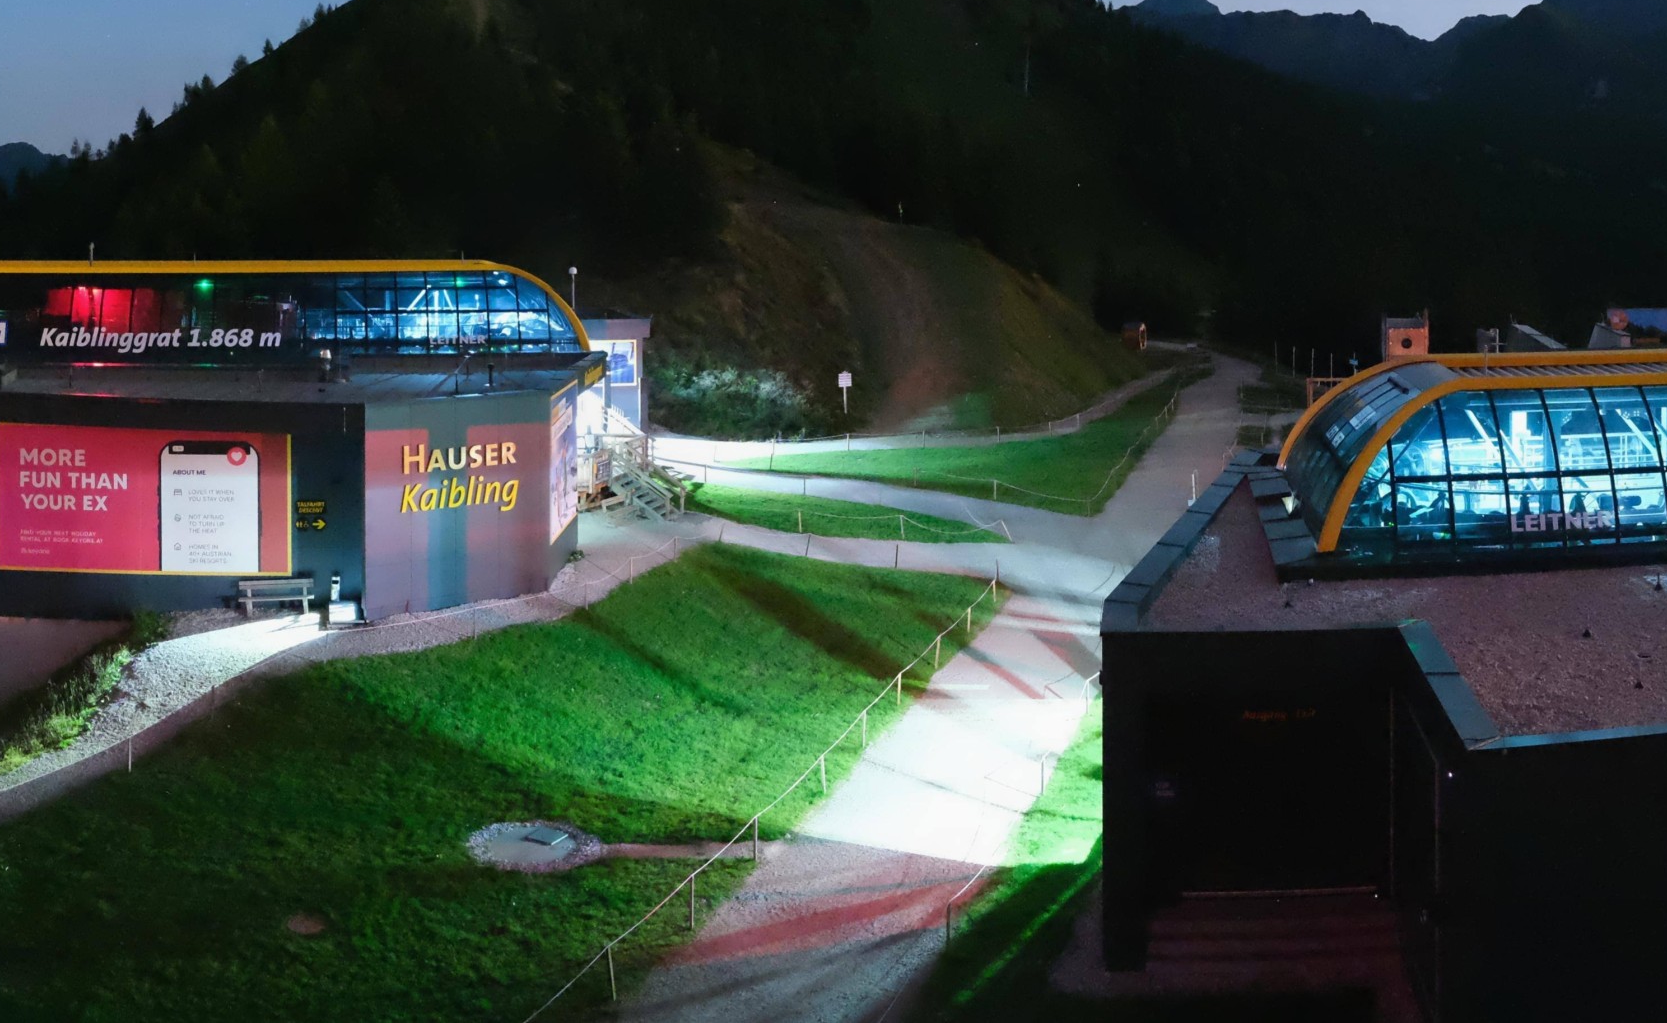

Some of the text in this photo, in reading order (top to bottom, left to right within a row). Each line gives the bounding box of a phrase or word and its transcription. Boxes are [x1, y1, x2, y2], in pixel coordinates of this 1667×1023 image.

[39, 327, 282, 354] Kaiblinggrat 1.868 m
[429, 334, 488, 345] LEITNER
[19, 448, 86, 466] MORE
[402, 442, 517, 474] HAUSER
[19, 471, 129, 490] FUN THAN
[20, 493, 109, 511] YOUR EX
[400, 475, 520, 514] Kaibling
[1510, 510, 1613, 533] LEITNER
